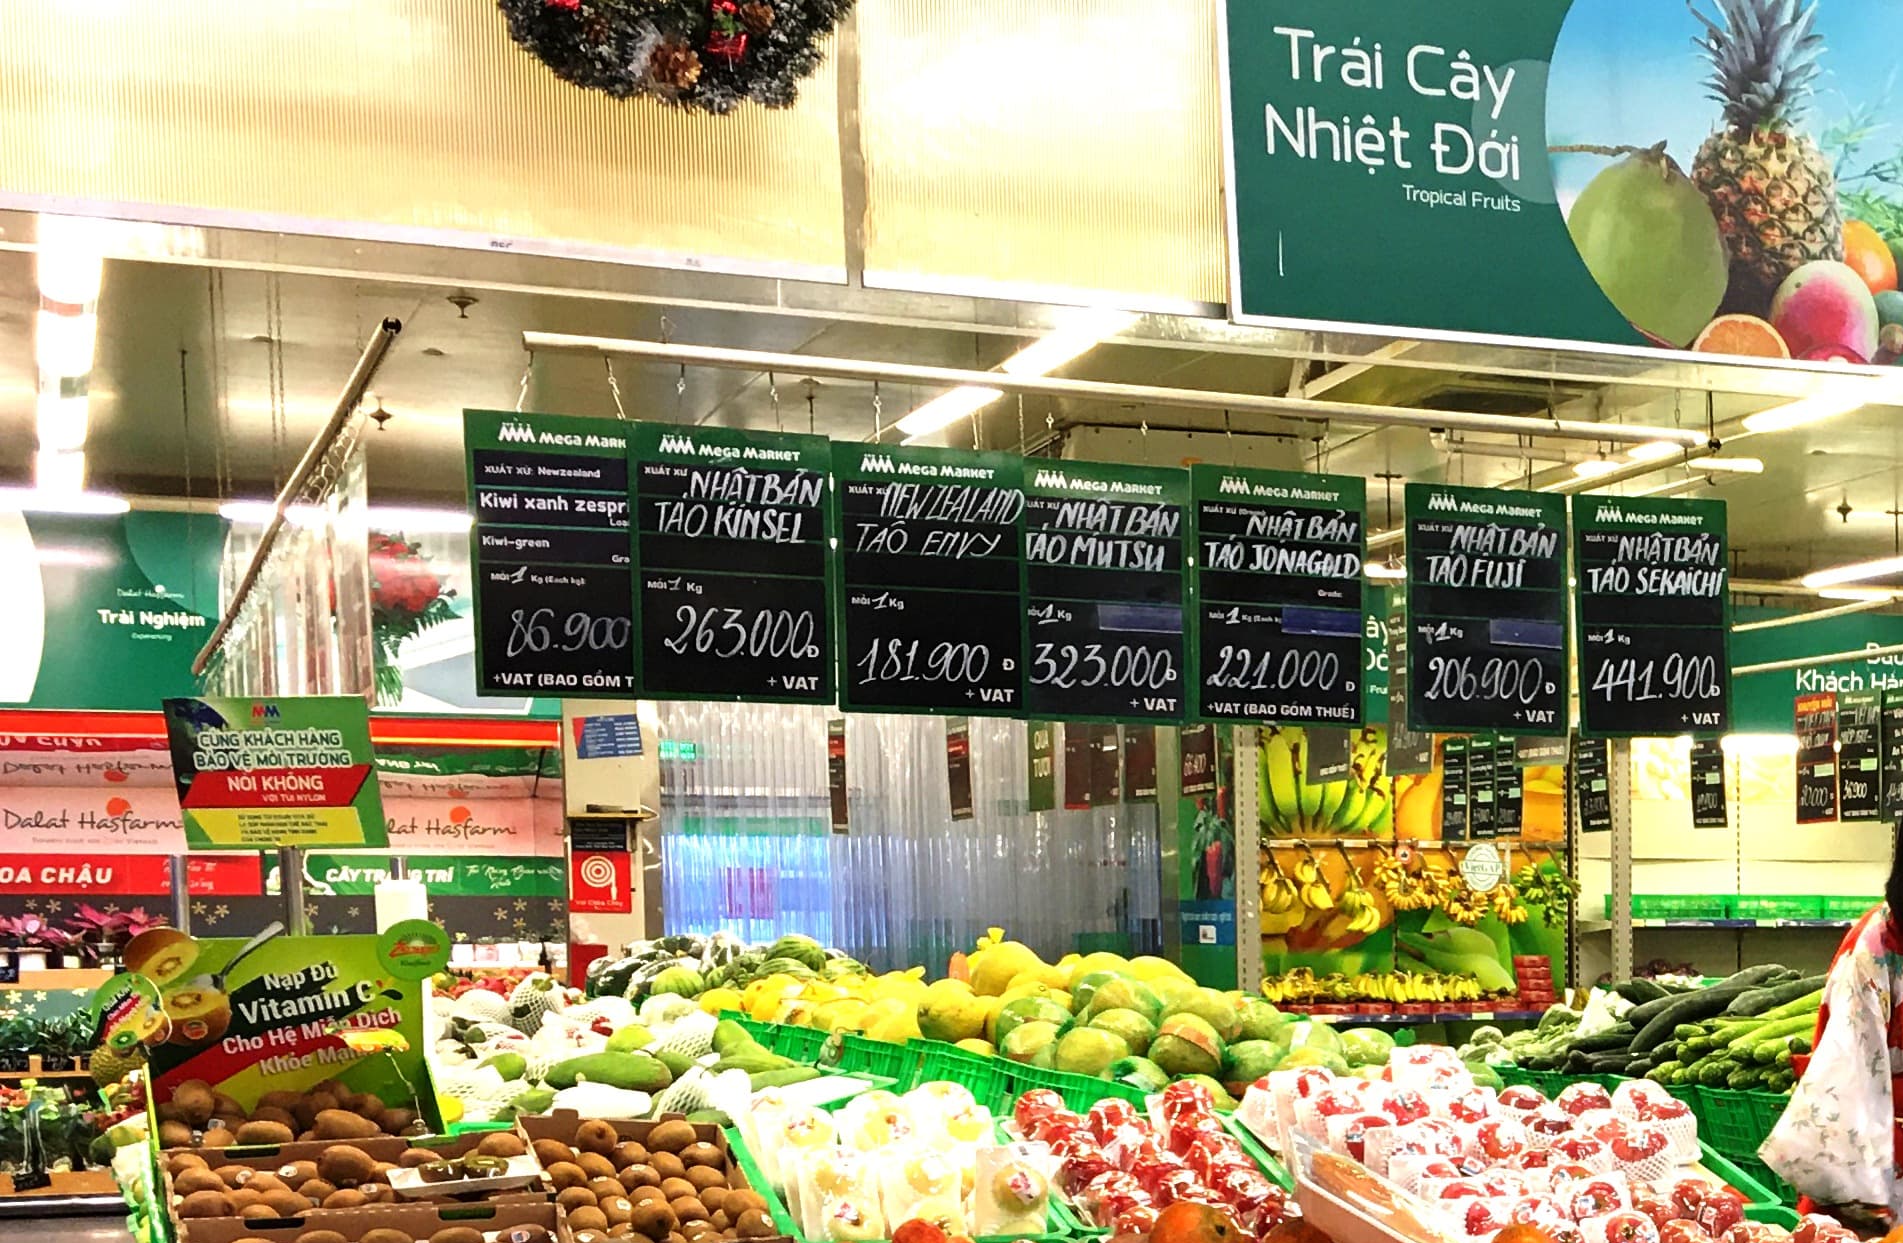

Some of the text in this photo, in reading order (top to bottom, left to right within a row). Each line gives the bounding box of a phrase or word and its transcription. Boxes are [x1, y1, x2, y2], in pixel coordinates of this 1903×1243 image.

[1273, 25, 1515, 120] Trái Cây
[1265, 104, 1521, 181] Nhiệt Đới
[1402, 184, 1521, 213] Tropical Fruits
[538, 467, 600, 478] Newzealand
[480, 492, 568, 511] Kiwi xanh
[482, 536, 550, 550] Kiwi-green
[1250, 544, 1360, 579] JONAGOLD
[1471, 558, 1527, 588] FUJI
[1635, 567, 1727, 598] SEKAICHI
[140, 611, 205, 630] Nghiệm
[507, 608, 631, 657] 86.900
[665, 606, 814, 658] 263.000
[857, 638, 990, 685] 181.900
[1029, 643, 1170, 689] 323.000
[1206, 645, 1339, 691] 221.000
[538, 673, 578, 687] (BAO
[783, 676, 818, 690] VAT
[1425, 655, 1543, 704] 206.900
[1592, 653, 1715, 701] 441.900
[1796, 670, 1863, 692] Khách
[980, 689, 1014, 703] VAT
[1144, 698, 1176, 711] VAT
[1244, 703, 1277, 715] (BAO
[1315, 703, 1355, 719] THUẾ)
[1526, 710, 1555, 723] VAT
[1692, 712, 1720, 726] VAT
[200, 729, 340, 747] CÙNG KHÁCH HÀNG
[195, 750, 350, 769] BẢO VỆ MÔI TRƯỜNG
[227, 773, 324, 791] NÓI KHÔNG
[3, 808, 183, 834] Dalat Hasfarm
[425, 818, 516, 839] Hasfarm
[0, 863, 112, 888] OA CHẬU
[326, 866, 358, 882] CÂY
[425, 866, 454, 882] TRÍ
[264, 960, 340, 993] Nạp Đủ
[239, 979, 376, 1025] Vitamin C
[222, 1006, 402, 1056] Cho Hệ Dịch
